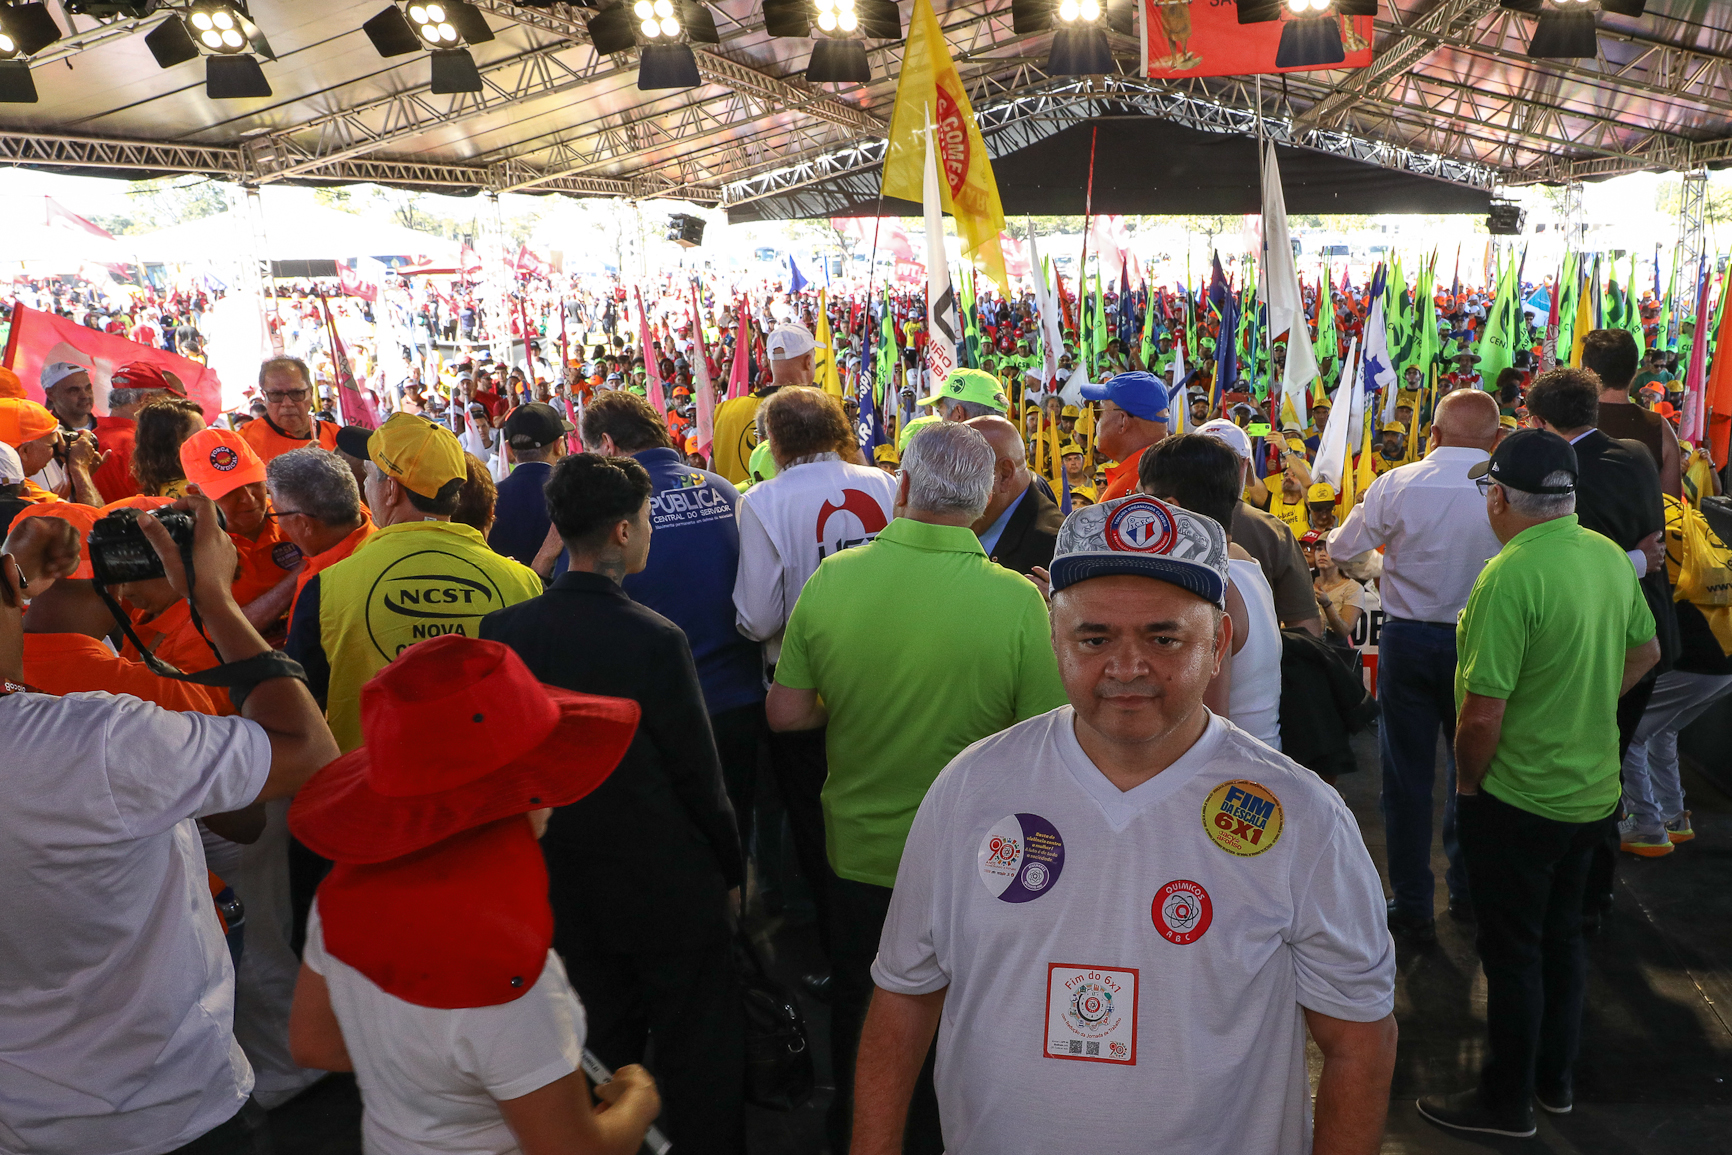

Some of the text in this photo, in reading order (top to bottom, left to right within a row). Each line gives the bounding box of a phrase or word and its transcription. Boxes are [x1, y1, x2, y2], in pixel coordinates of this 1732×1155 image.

[653, 513, 685, 523] CENTRAL
[700, 505, 731, 516] SERVIDOR
[400, 588, 475, 604] NCST
[413, 624, 466, 638] NOVA
[1225, 785, 1276, 820] FIM
[1220, 800, 1234, 814] DA
[1233, 807, 1268, 830] ESCALA
[1165, 881, 1205, 900] QUÍMICOS
[1064, 971, 1121, 993] Fim do 6x1
